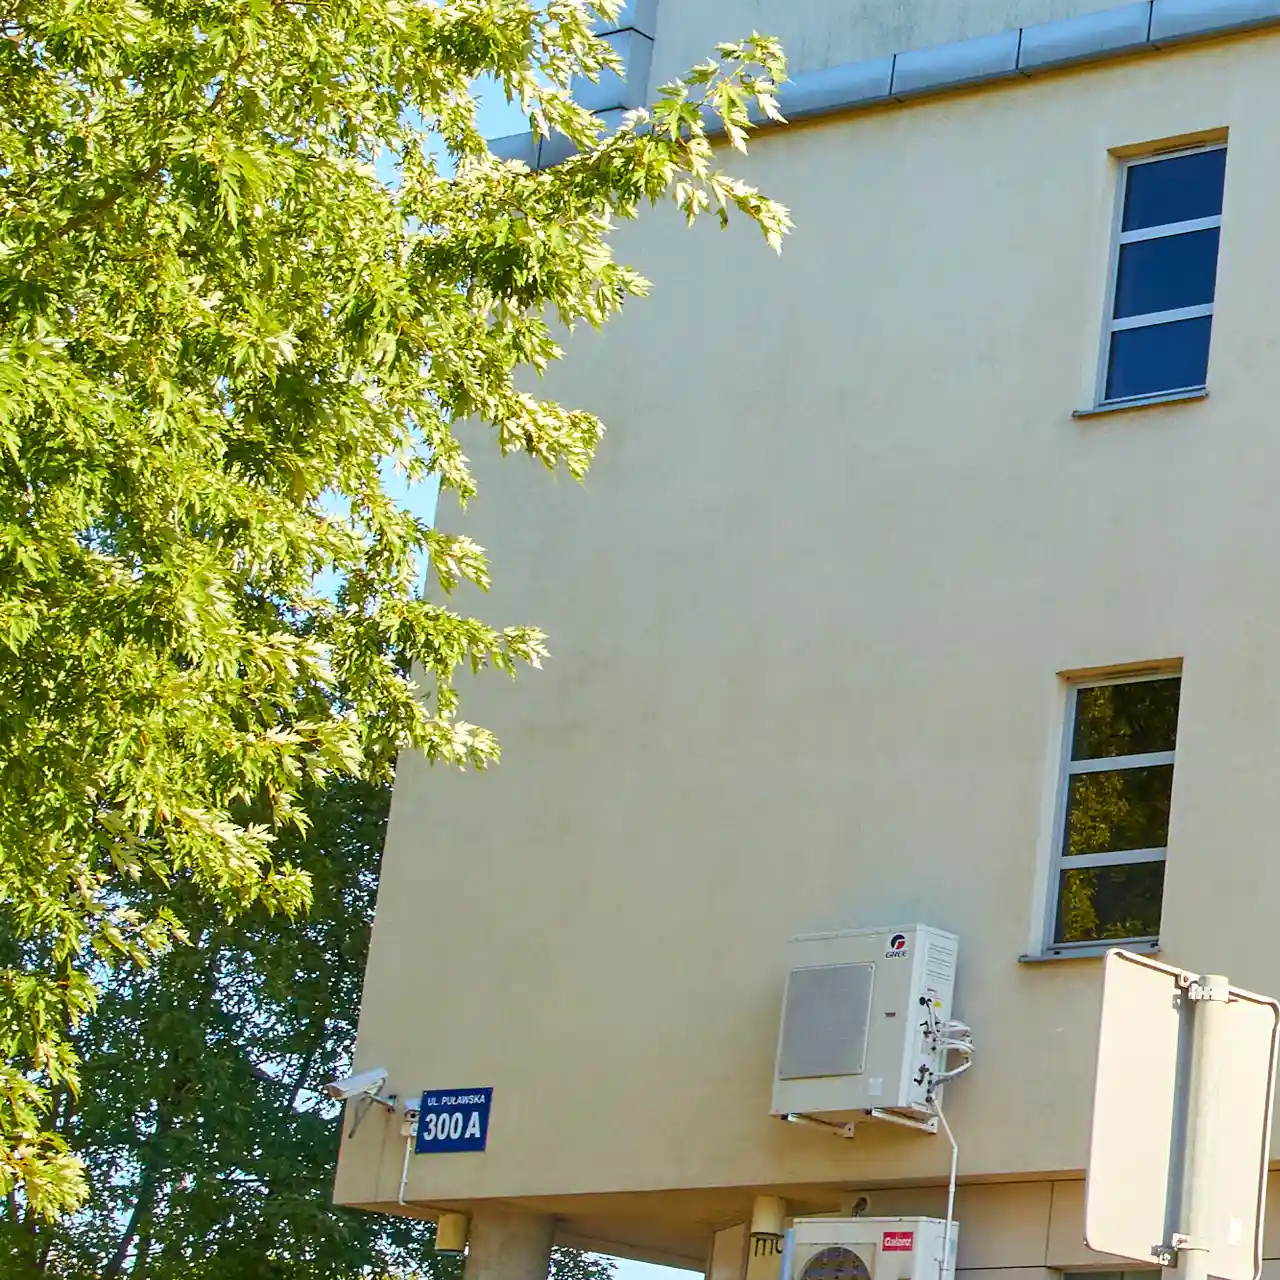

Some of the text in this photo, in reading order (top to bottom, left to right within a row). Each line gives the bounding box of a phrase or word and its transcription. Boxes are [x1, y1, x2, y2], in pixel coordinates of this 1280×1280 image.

[441, 1095, 485, 1105] PUŁAWSKA
[423, 1111, 481, 1140] 300 A
